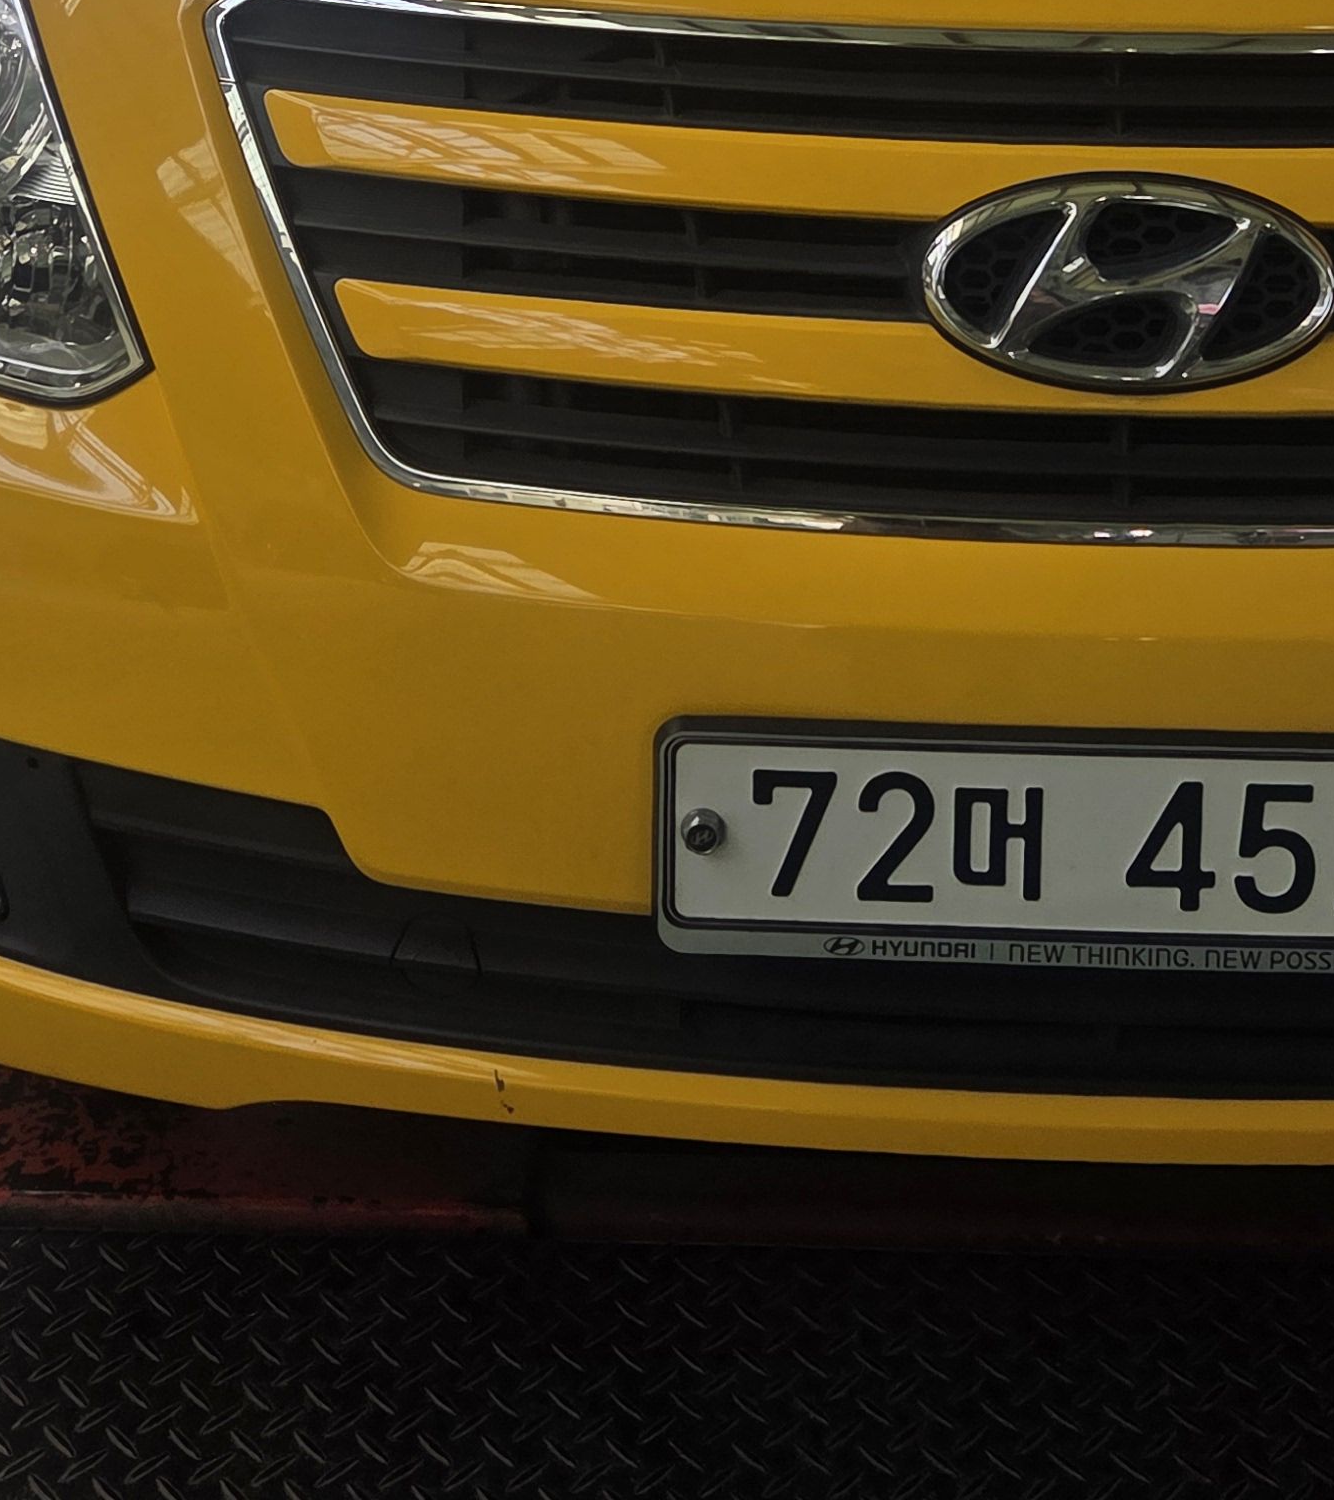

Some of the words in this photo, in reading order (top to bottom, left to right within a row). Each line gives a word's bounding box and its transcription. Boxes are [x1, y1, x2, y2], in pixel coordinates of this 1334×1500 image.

[752, 769, 1044, 903] 72머
[871, 939, 976, 959] HYUNDAI
[1009, 943, 1065, 963] NEW
[1071, 945, 1195, 969] THINKING.
[1205, 948, 1262, 969] NEW
